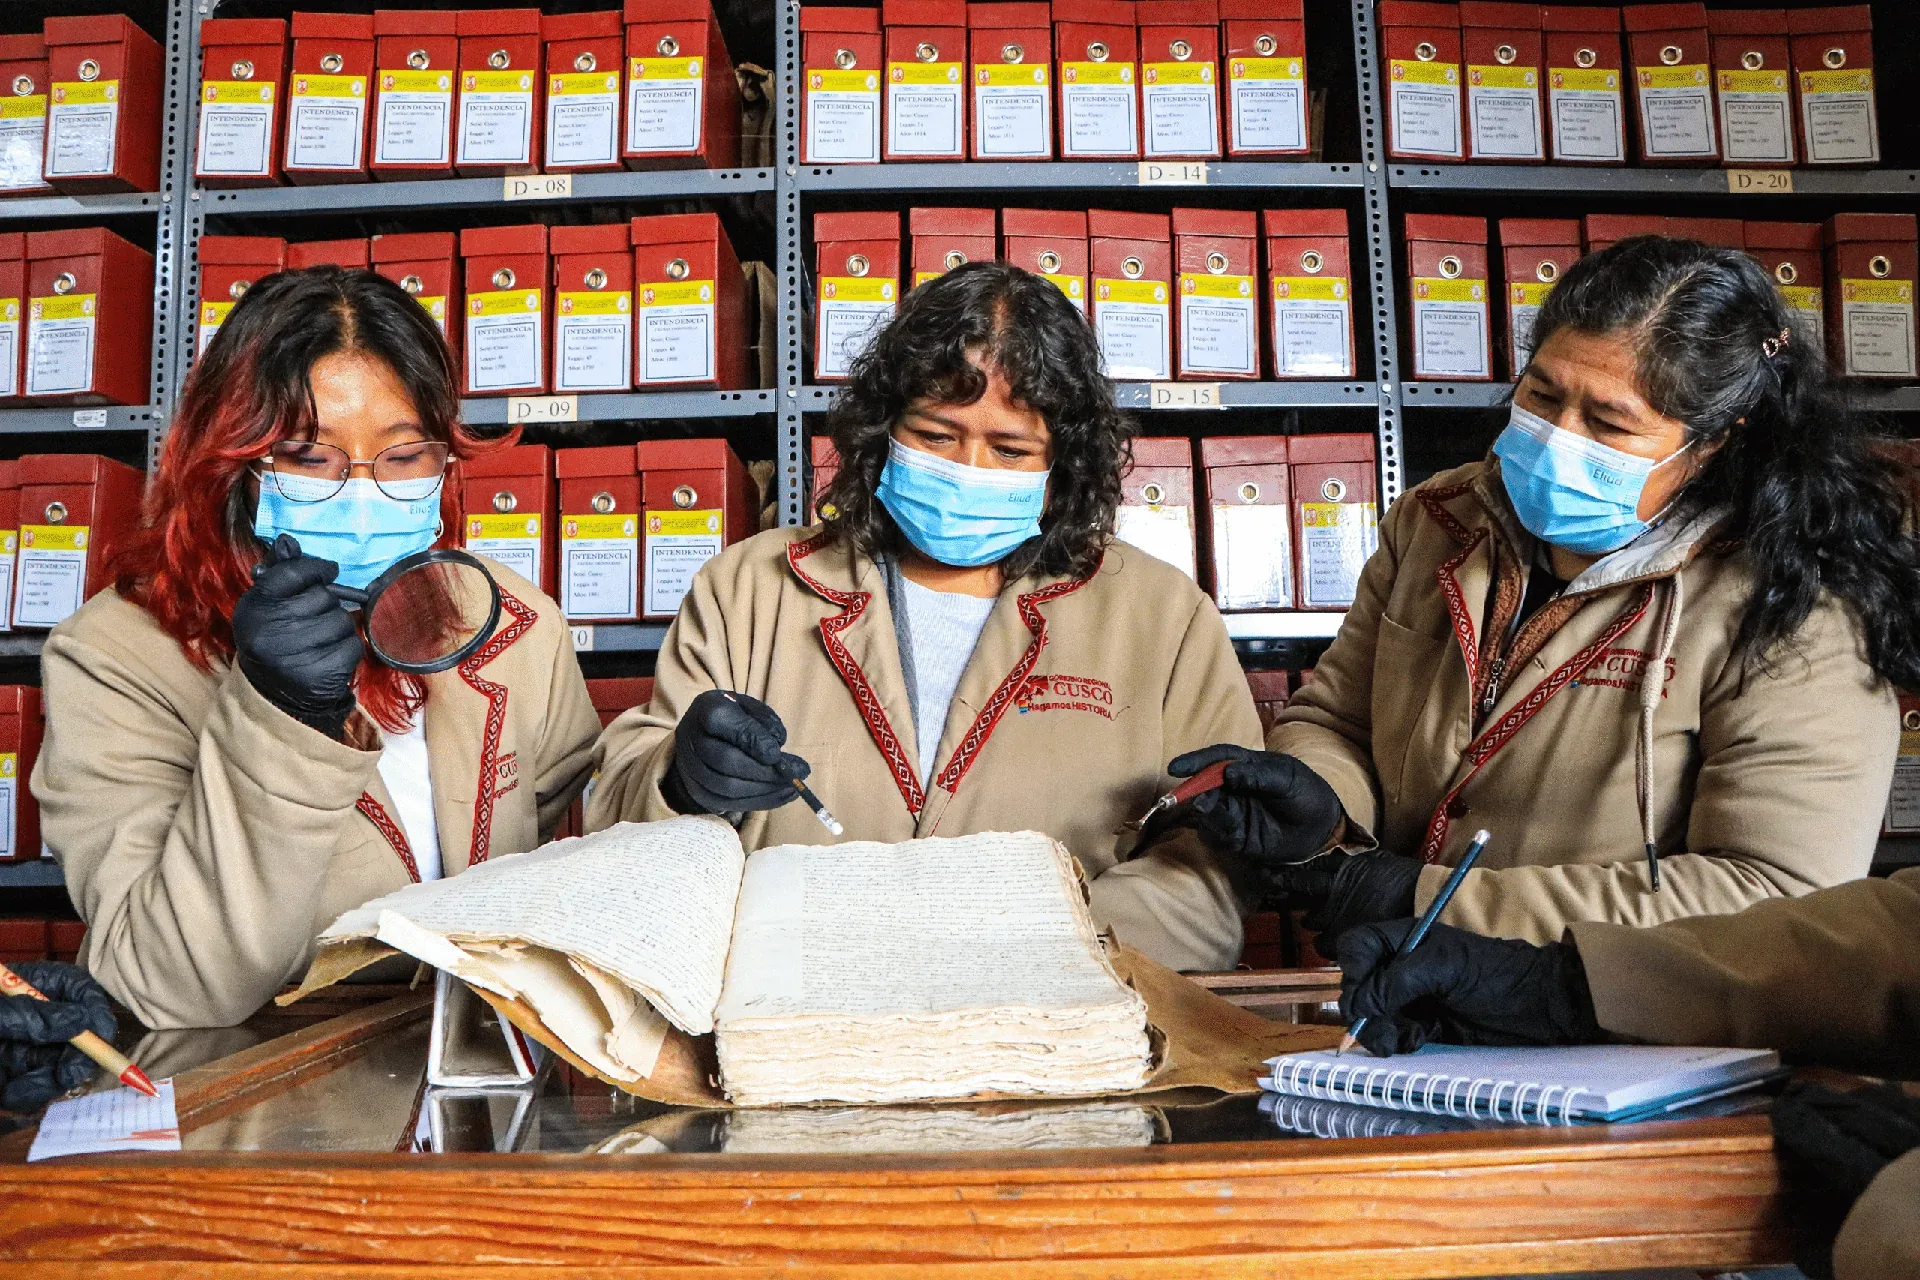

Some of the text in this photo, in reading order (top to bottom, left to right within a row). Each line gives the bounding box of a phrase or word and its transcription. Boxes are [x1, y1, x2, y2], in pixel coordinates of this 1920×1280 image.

[1400, 94, 1452, 104] INTENDENCIA
[1478, 99, 1530, 107] INTENDENCIA
[557, 105, 610, 113] INTENDENCIA
[1812, 103, 1865, 111] INTENDENCIA
[58, 116, 109, 124] INTENDENCIA
[1149, 166, 1162, 180] D
[1183, 166, 1201, 180] 14
[1738, 174, 1751, 188] D
[1769, 174, 1787, 188] 20
[514, 181, 528, 195] D
[546, 179, 566, 193] 08
[1191, 309, 1245, 318] INTENDENCIA
[1424, 313, 1477, 321] INTENDENCIA
[649, 318, 704, 326] INTENDENCIA
[1105, 315, 1160, 323] INTENDENCIA
[477, 326, 532, 336] INTENDENCIA
[1157, 389, 1171, 403] D
[1192, 389, 1210, 404] 15
[517, 403, 531, 418] D
[549, 402, 570, 417] 09
[1593, 469, 1624, 486] Eliud
[572, 552, 628, 560] INTENDENCIA
[1607, 656, 1676, 682] CUSO
[1053, 682, 1113, 705] CUSCO
[1072, 702, 1113, 720] HISTORIA
